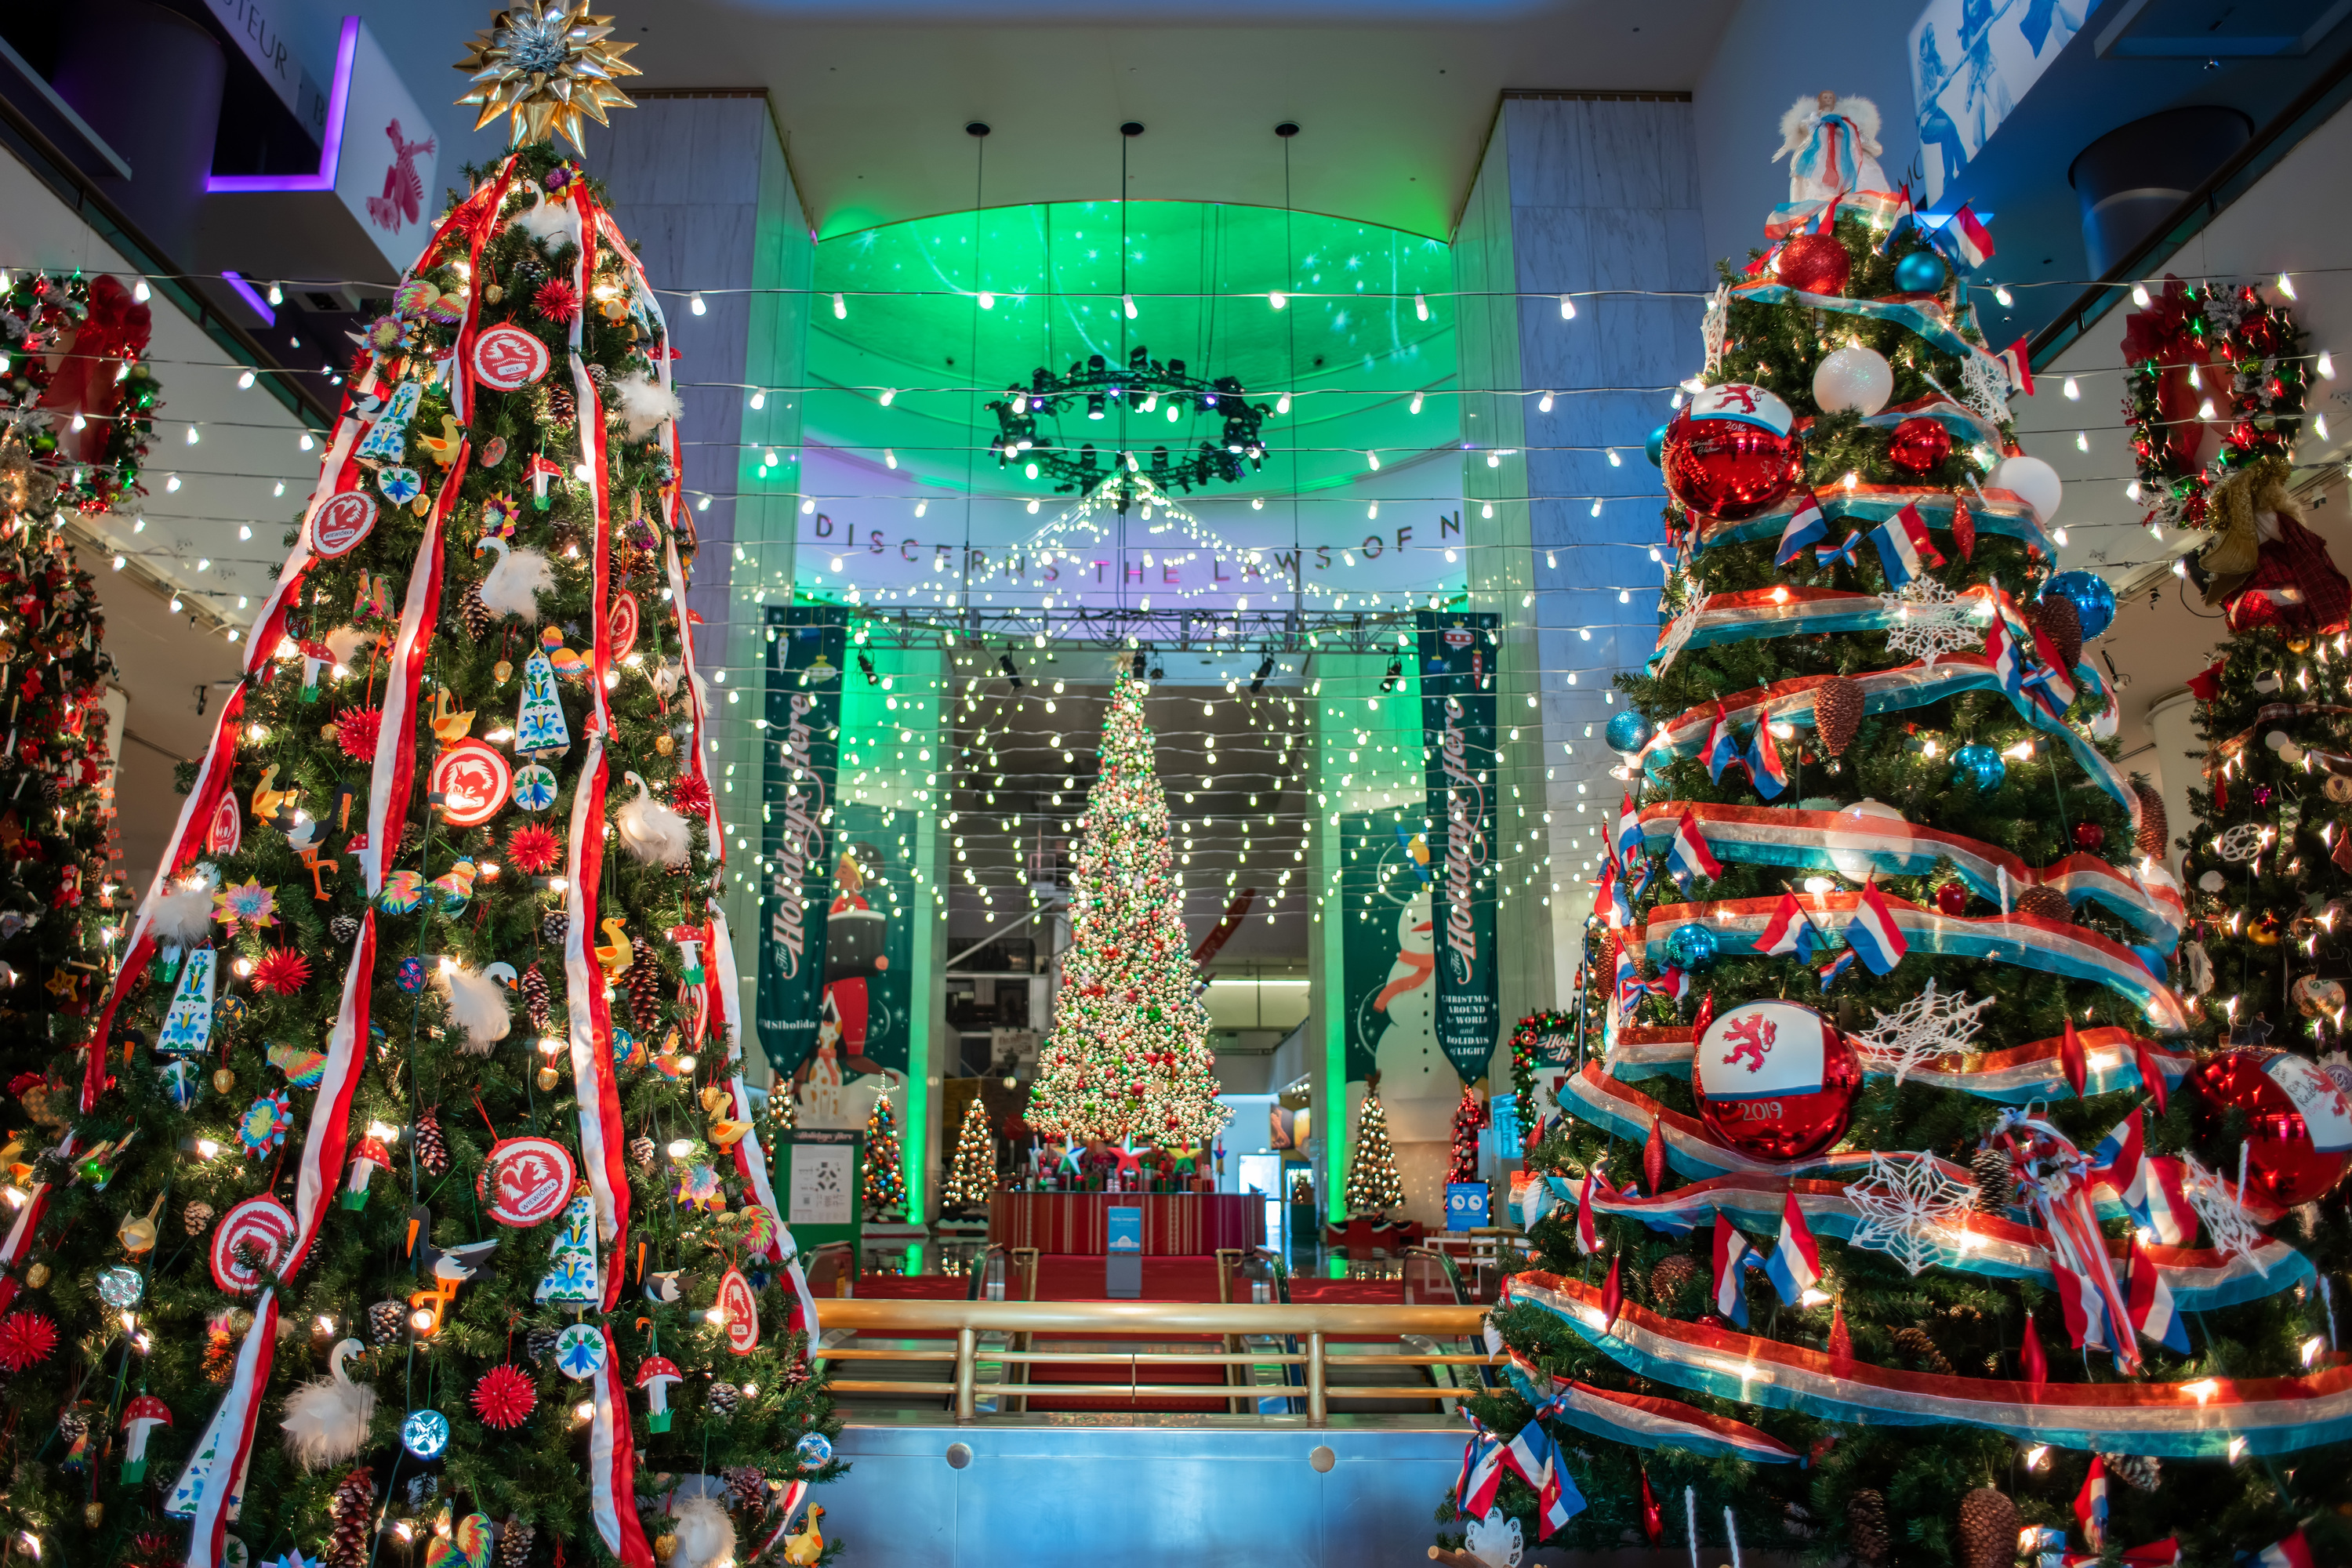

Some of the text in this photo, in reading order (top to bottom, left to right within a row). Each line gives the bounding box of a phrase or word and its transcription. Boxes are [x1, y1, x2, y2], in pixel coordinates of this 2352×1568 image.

[1724, 421, 1748, 432] 2016
[325, 530, 353, 539] WIEWIÓRKA
[816, 513, 1059, 582] DISCERNS
[1094, 560, 1180, 584] THE
[1214, 545, 1332, 582] LAWS
[1362, 525, 1414, 560] OF
[780, 695, 819, 792] Here
[1443, 699, 1478, 793] Here
[773, 789, 825, 979] Holidays
[1445, 793, 1487, 985] Holidays
[1449, 1005, 1486, 1014] AROUND
[1455, 1015, 1488, 1025] WORLD
[1446, 1035, 1489, 1044] HOLIDAYS
[1457, 1047, 1486, 1055] LIGHT
[1737, 1101, 1783, 1121] 2019
[521, 1181, 557, 1210] WIEWIÓRKA
